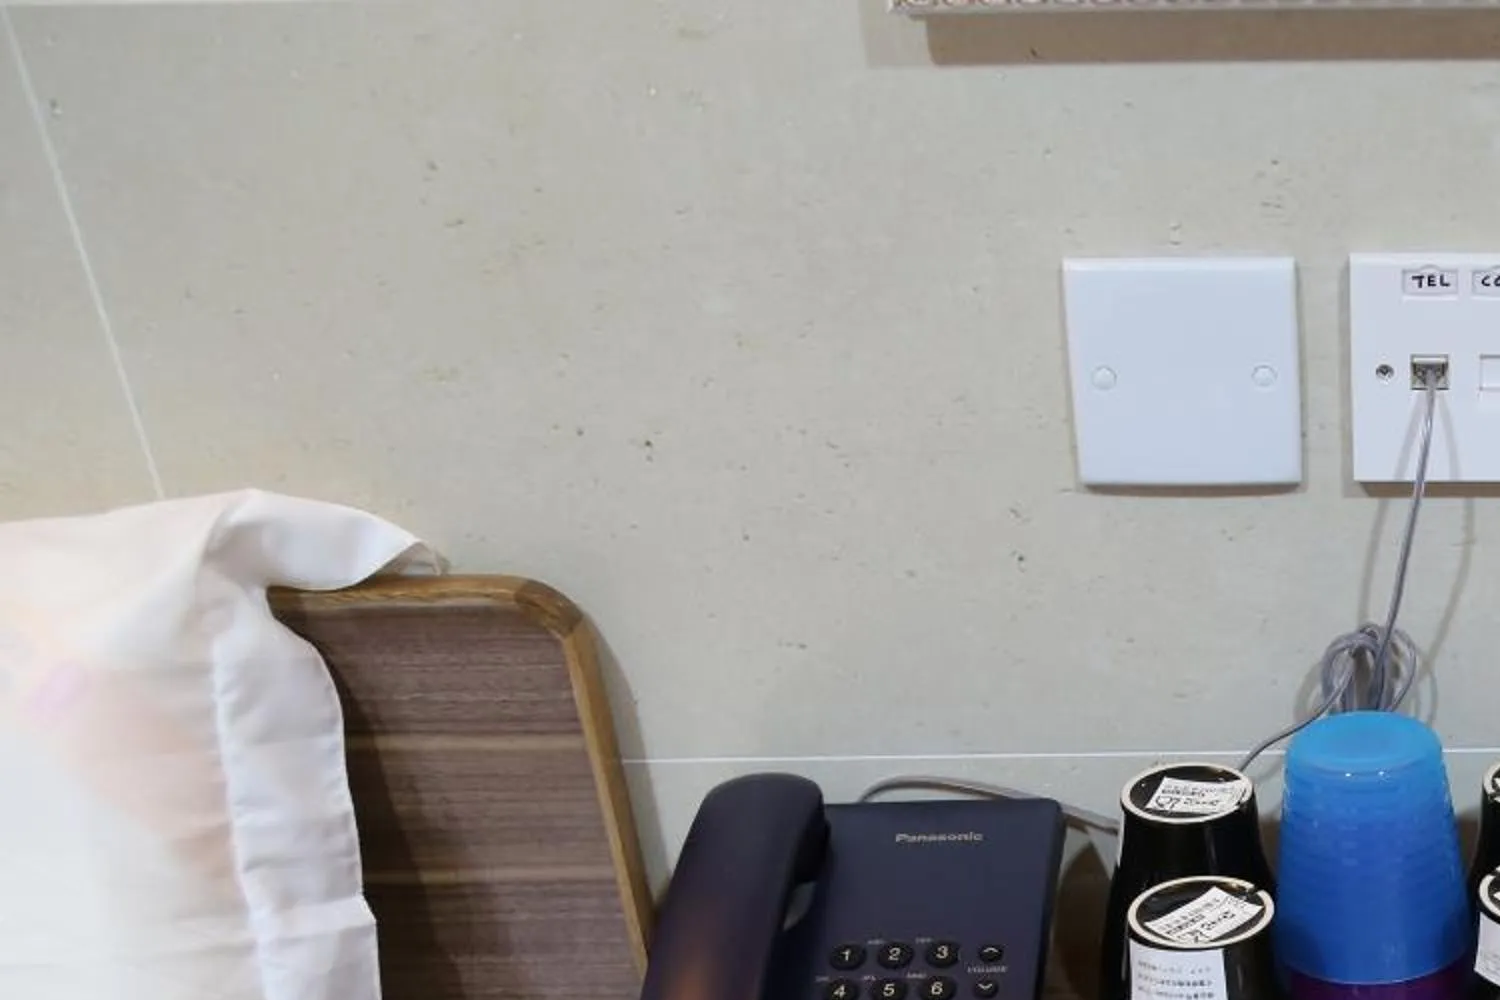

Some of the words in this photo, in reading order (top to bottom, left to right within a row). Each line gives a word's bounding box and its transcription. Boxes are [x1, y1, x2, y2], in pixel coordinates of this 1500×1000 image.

[1411, 274, 1451, 289] TEL
[895, 831, 983, 843] Panasonic
[887, 947, 901, 961] 2
[935, 945, 949, 959] 3
[833, 984, 846, 998] 4
[883, 983, 896, 997] 5
[930, 981, 943, 995] 6
